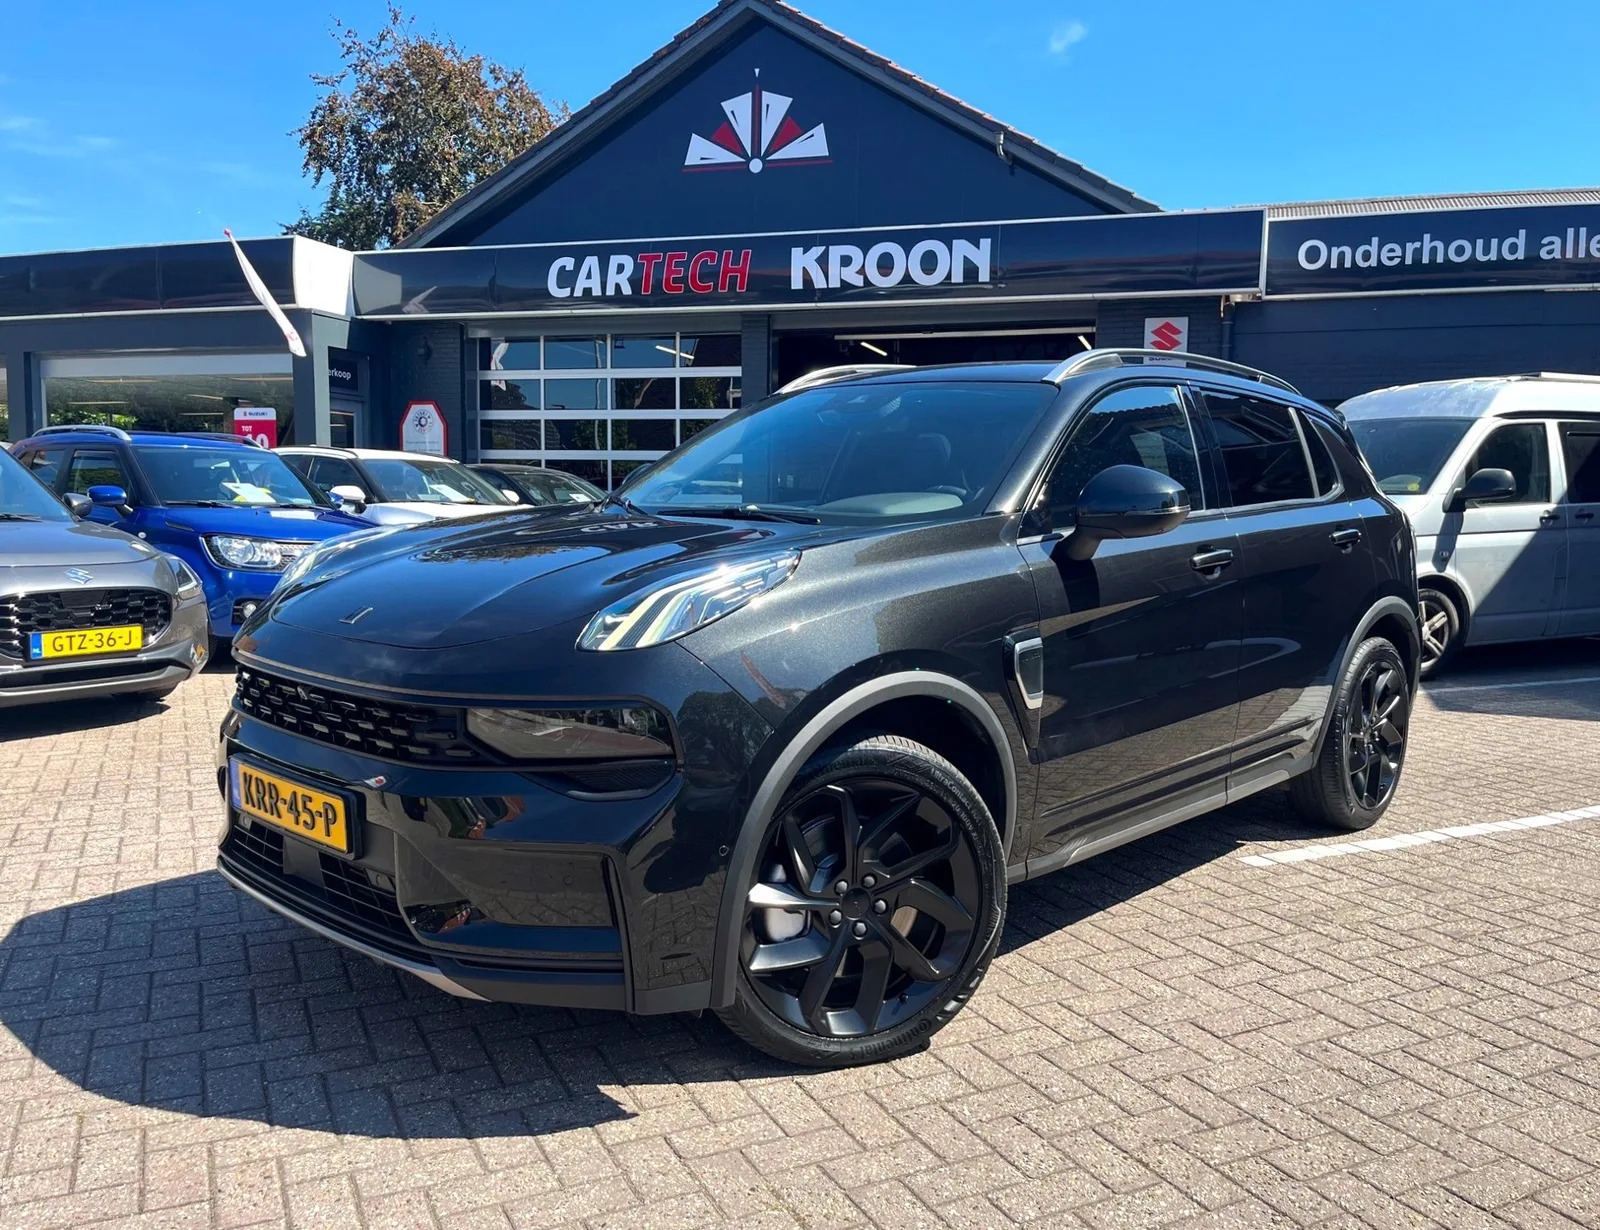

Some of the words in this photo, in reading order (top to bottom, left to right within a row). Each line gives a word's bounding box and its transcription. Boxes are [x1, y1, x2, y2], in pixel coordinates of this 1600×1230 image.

[547, 249, 753, 298] CARTECH
[790, 238, 992, 291] KROON
[1297, 229, 1527, 271] Onderhoud
[328, 368, 352, 381] erkoop
[52, 630, 132, 653] GTZ-36-J
[242, 771, 338, 838] KRR-45-P
